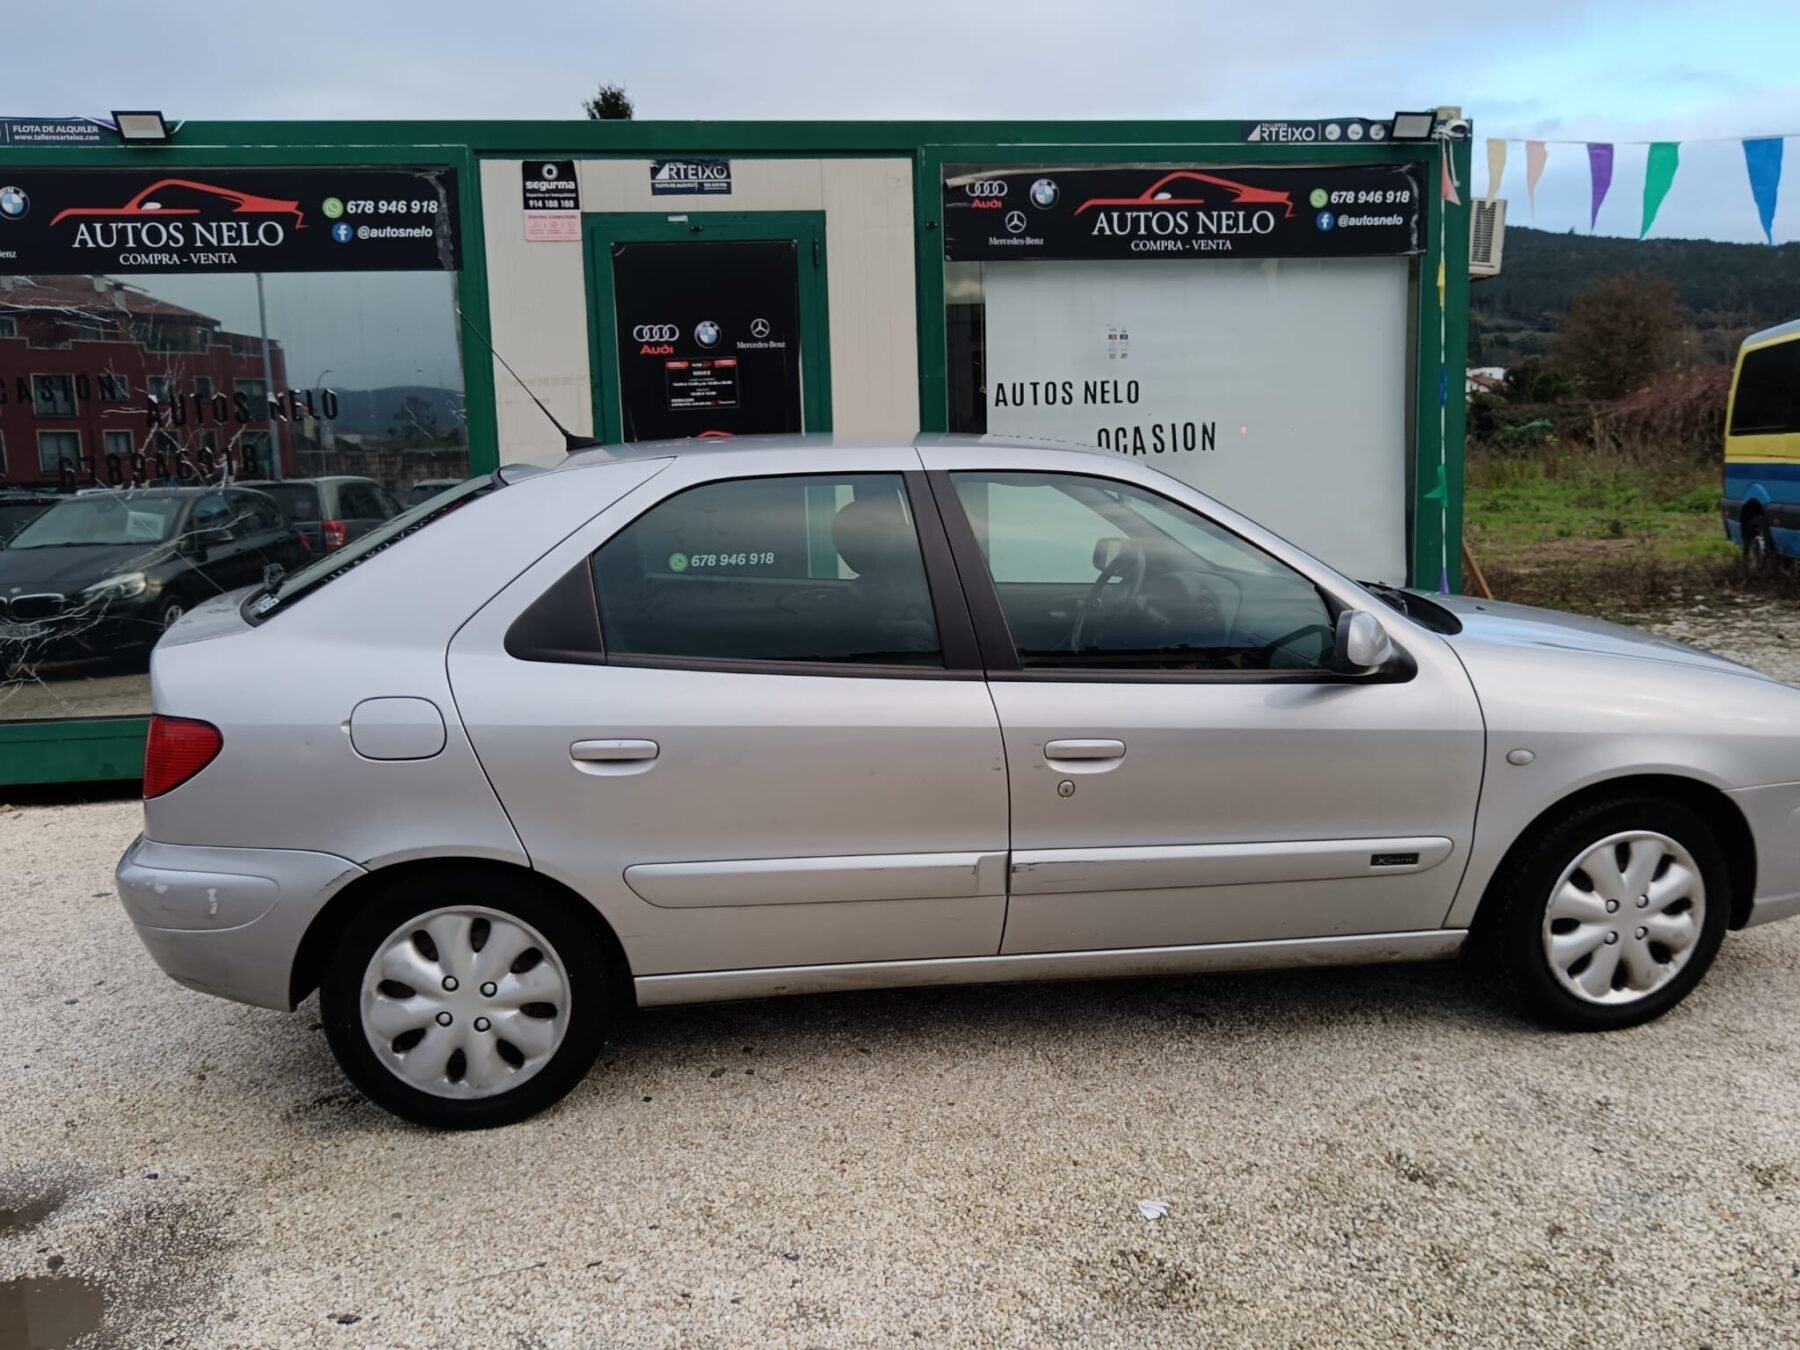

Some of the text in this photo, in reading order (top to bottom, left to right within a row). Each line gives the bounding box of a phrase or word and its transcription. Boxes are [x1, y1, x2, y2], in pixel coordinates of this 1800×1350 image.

[13, 125, 99, 134] FLOTA DE ALQUILER
[525, 181, 576, 191] segurma
[972, 199, 1002, 208] Audi
[1331, 190, 1409, 204] 678 946 918
[347, 199, 438, 214] 678 946 918
[1092, 210, 1275, 237] AUTOS NELO
[1337, 213, 1403, 227] @autosnelo
[72, 221, 284, 248] AUTOS NELO
[357, 225, 433, 239] @autosnelo
[988, 237, 1044, 246] Mercedes-Benz
[1131, 240, 1183, 252] COMPRA
[1192, 240, 1232, 251] VENTA
[0, 250, 17, 258] enz
[119, 253, 180, 265] COMPRA
[189, 252, 237, 265] VENTA
[640, 345, 674, 355] Audi
[737, 341, 786, 349] Mercedes-Benz
[994, 379, 1140, 407] AUTOS NELO
[147, 388, 338, 427] AUTOS NELO
[1097, 421, 1216, 456] OCASION
[691, 552, 775, 567] 678 946 918
